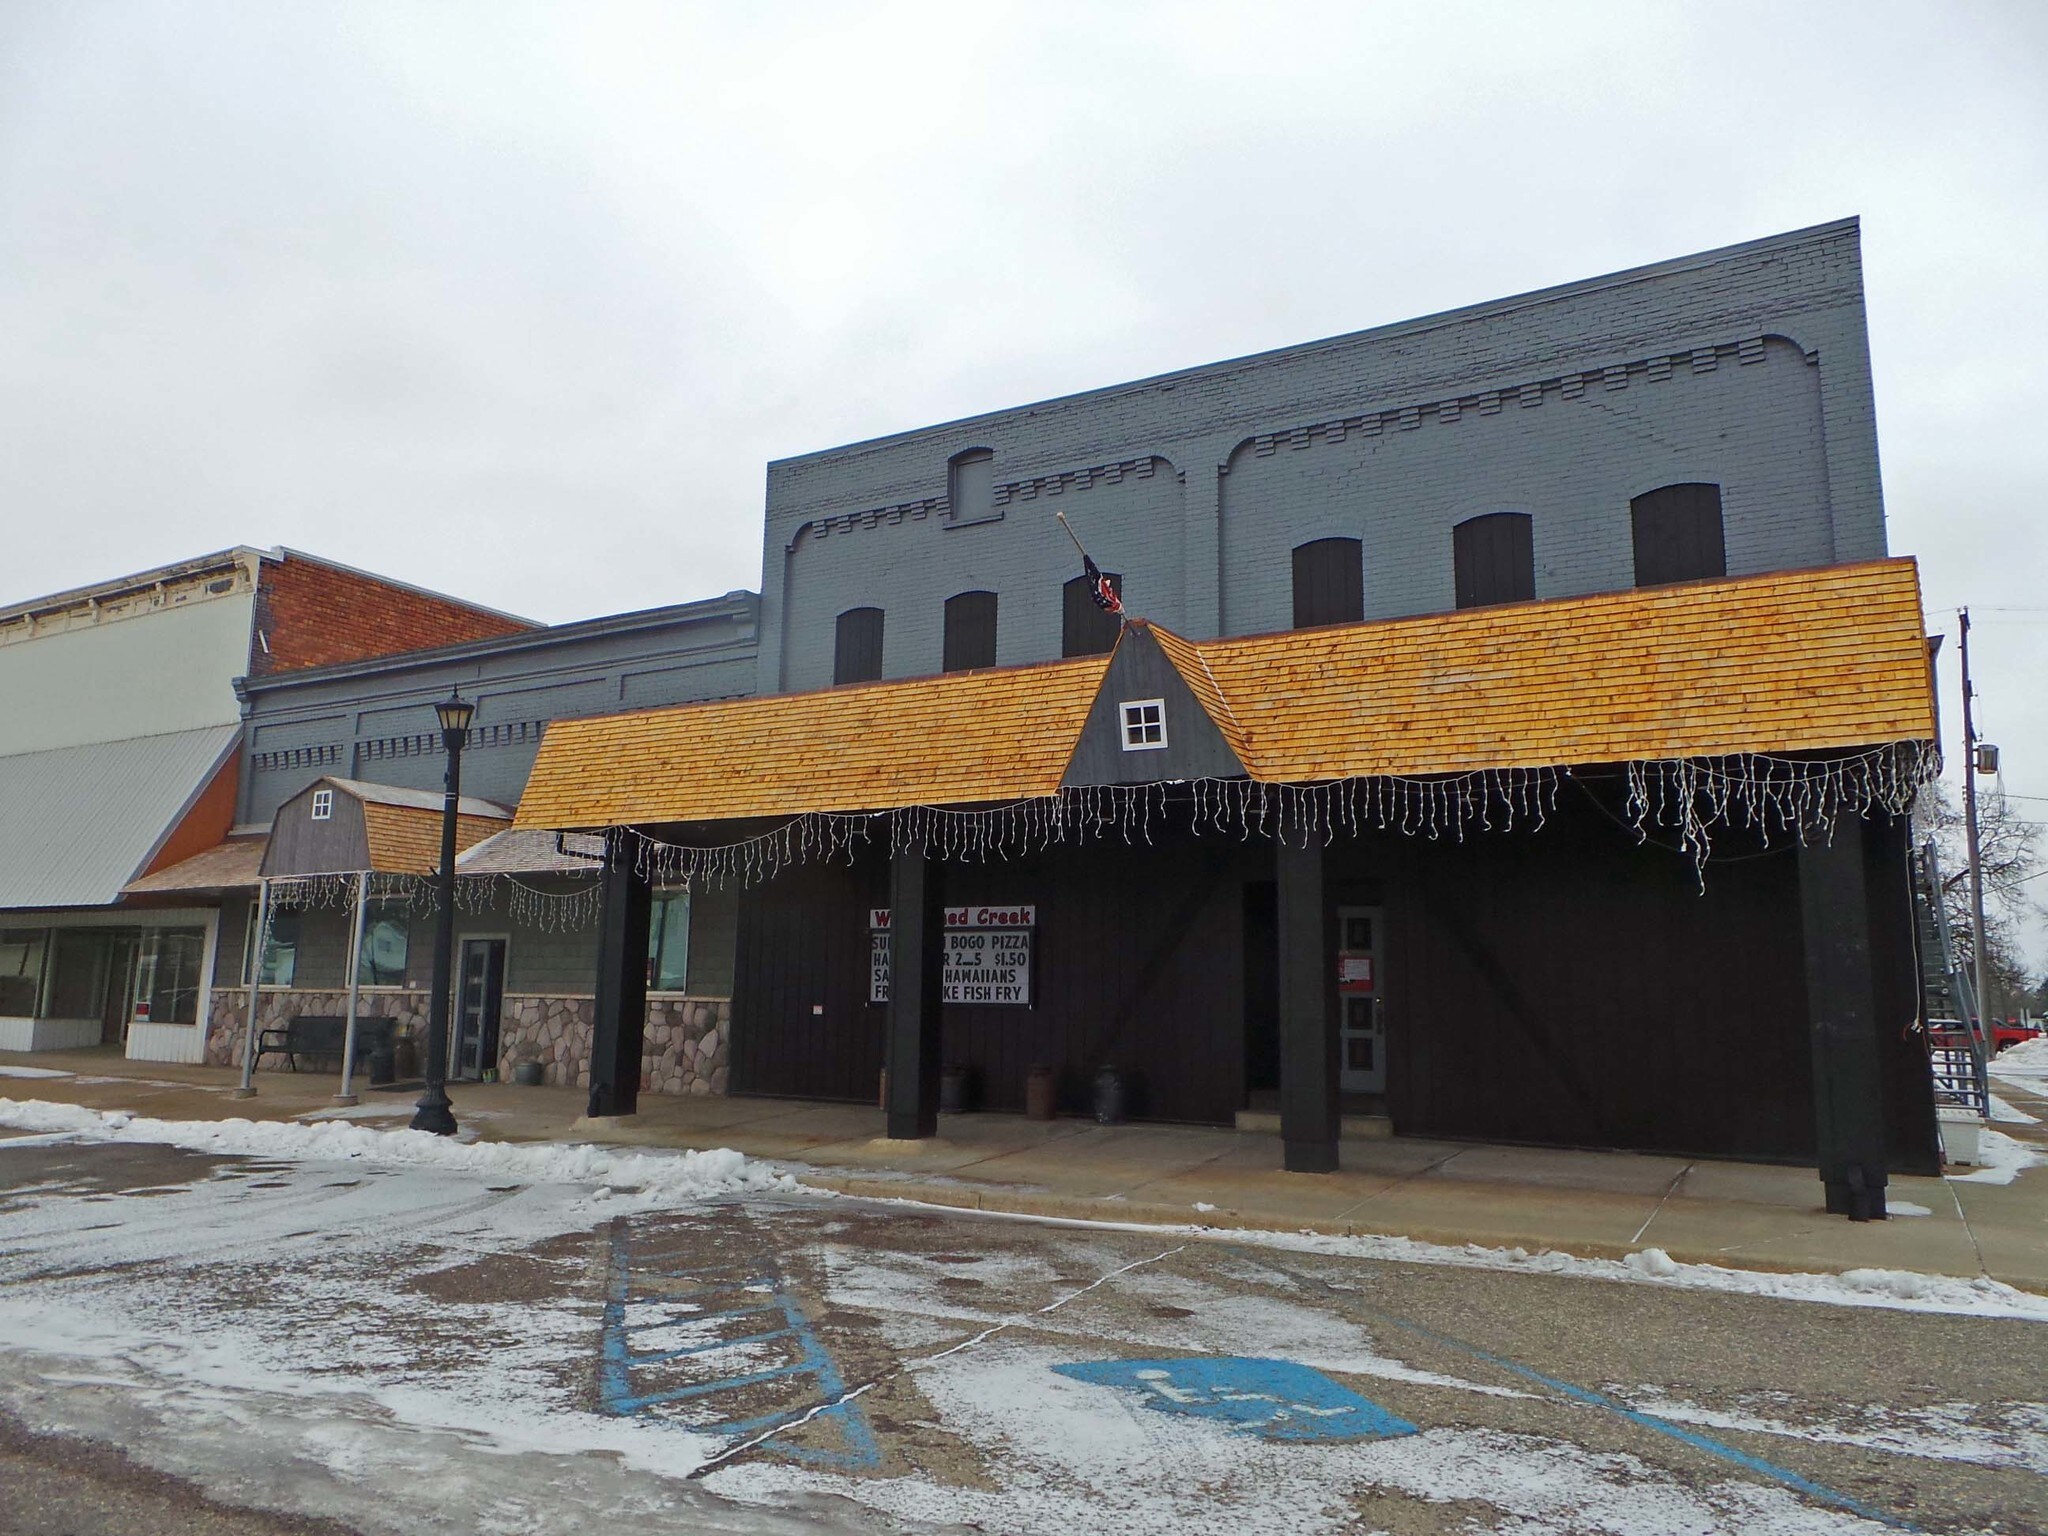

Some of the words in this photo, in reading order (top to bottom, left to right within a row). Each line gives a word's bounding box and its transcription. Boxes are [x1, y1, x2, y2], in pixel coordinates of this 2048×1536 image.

[977, 907, 1031, 925] Creek
[951, 935, 985, 950] BOGO
[991, 935, 1028, 950] PIZZA
[994, 952, 1027, 967] $1.50
[945, 969, 1016, 983] HAWAIIANS
[963, 986, 991, 1000] FISH
[995, 986, 1022, 1001] FRY
